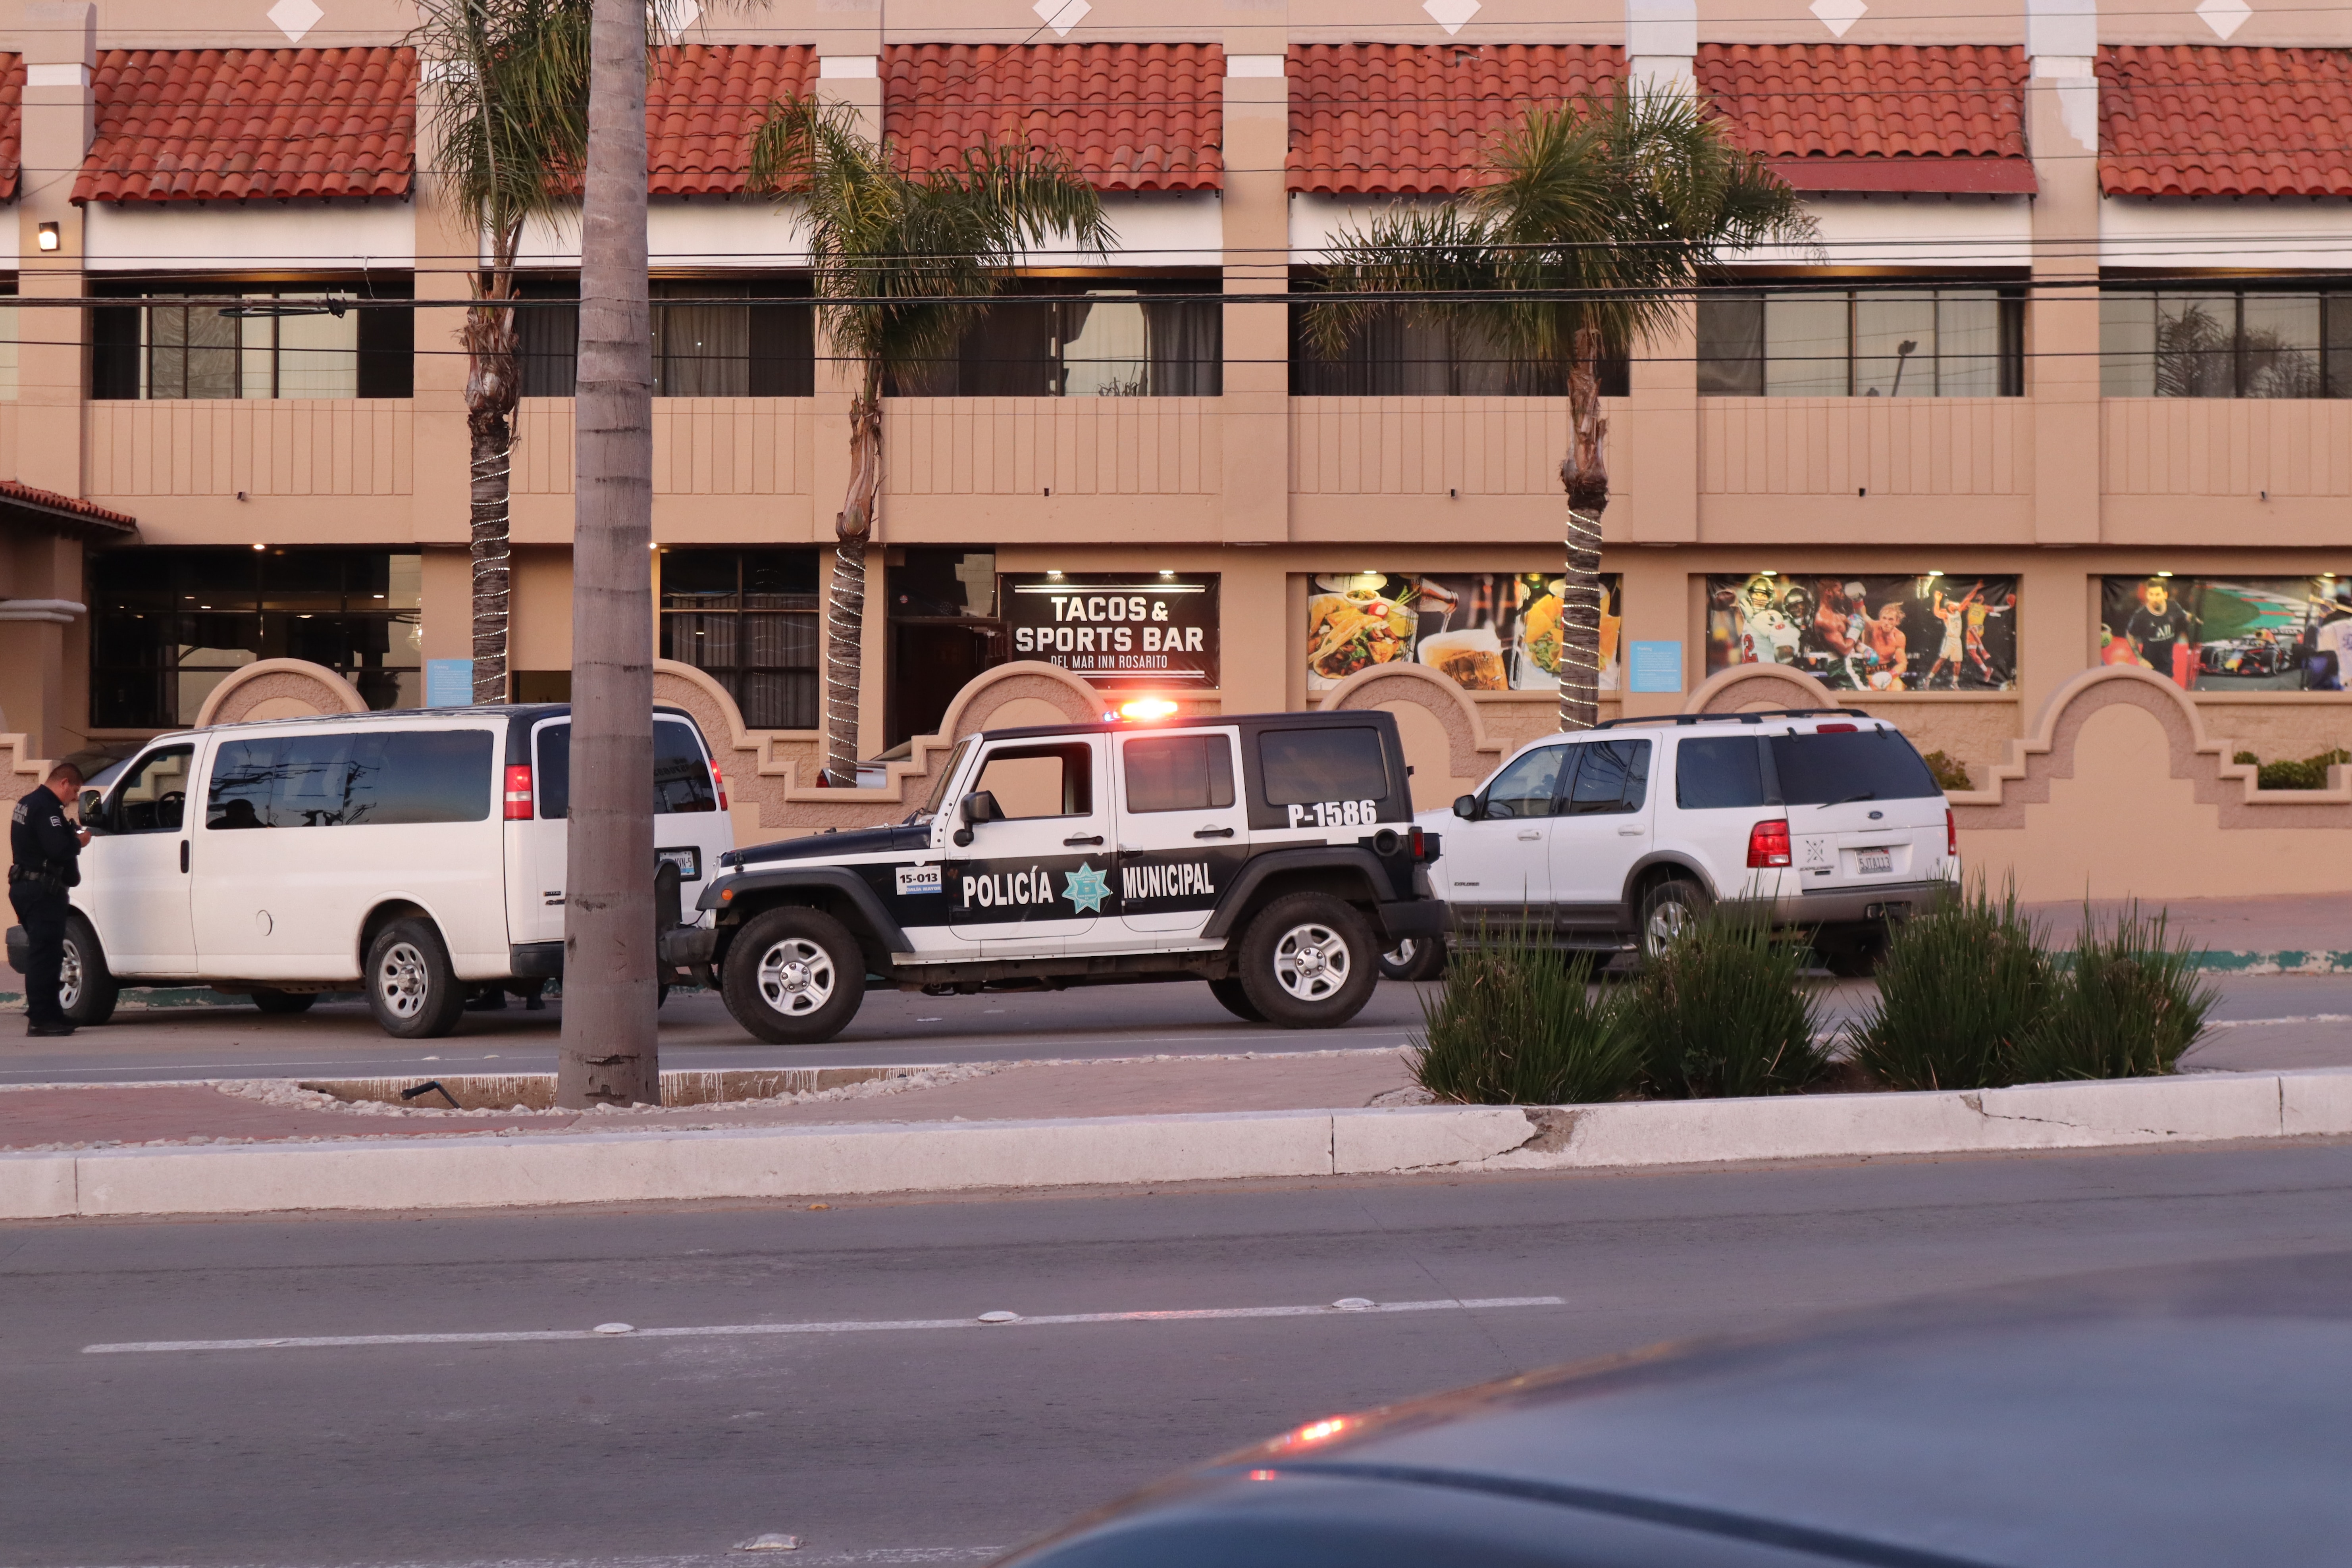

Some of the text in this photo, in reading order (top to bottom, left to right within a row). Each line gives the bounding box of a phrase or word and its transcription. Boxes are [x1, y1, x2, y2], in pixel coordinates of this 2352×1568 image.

[1051, 597, 1168, 622] TACOS &
[1016, 627, 1204, 652] SPORTS BAR
[1051, 655, 1168, 668] DEL MAR INN ROSARITO
[1287, 799, 1377, 828] P-1586
[1859, 857, 1890, 870] 5JTA113
[900, 873, 938, 884] 15-013
[962, 862, 1215, 908] POLICÍA MUNICIPAL
